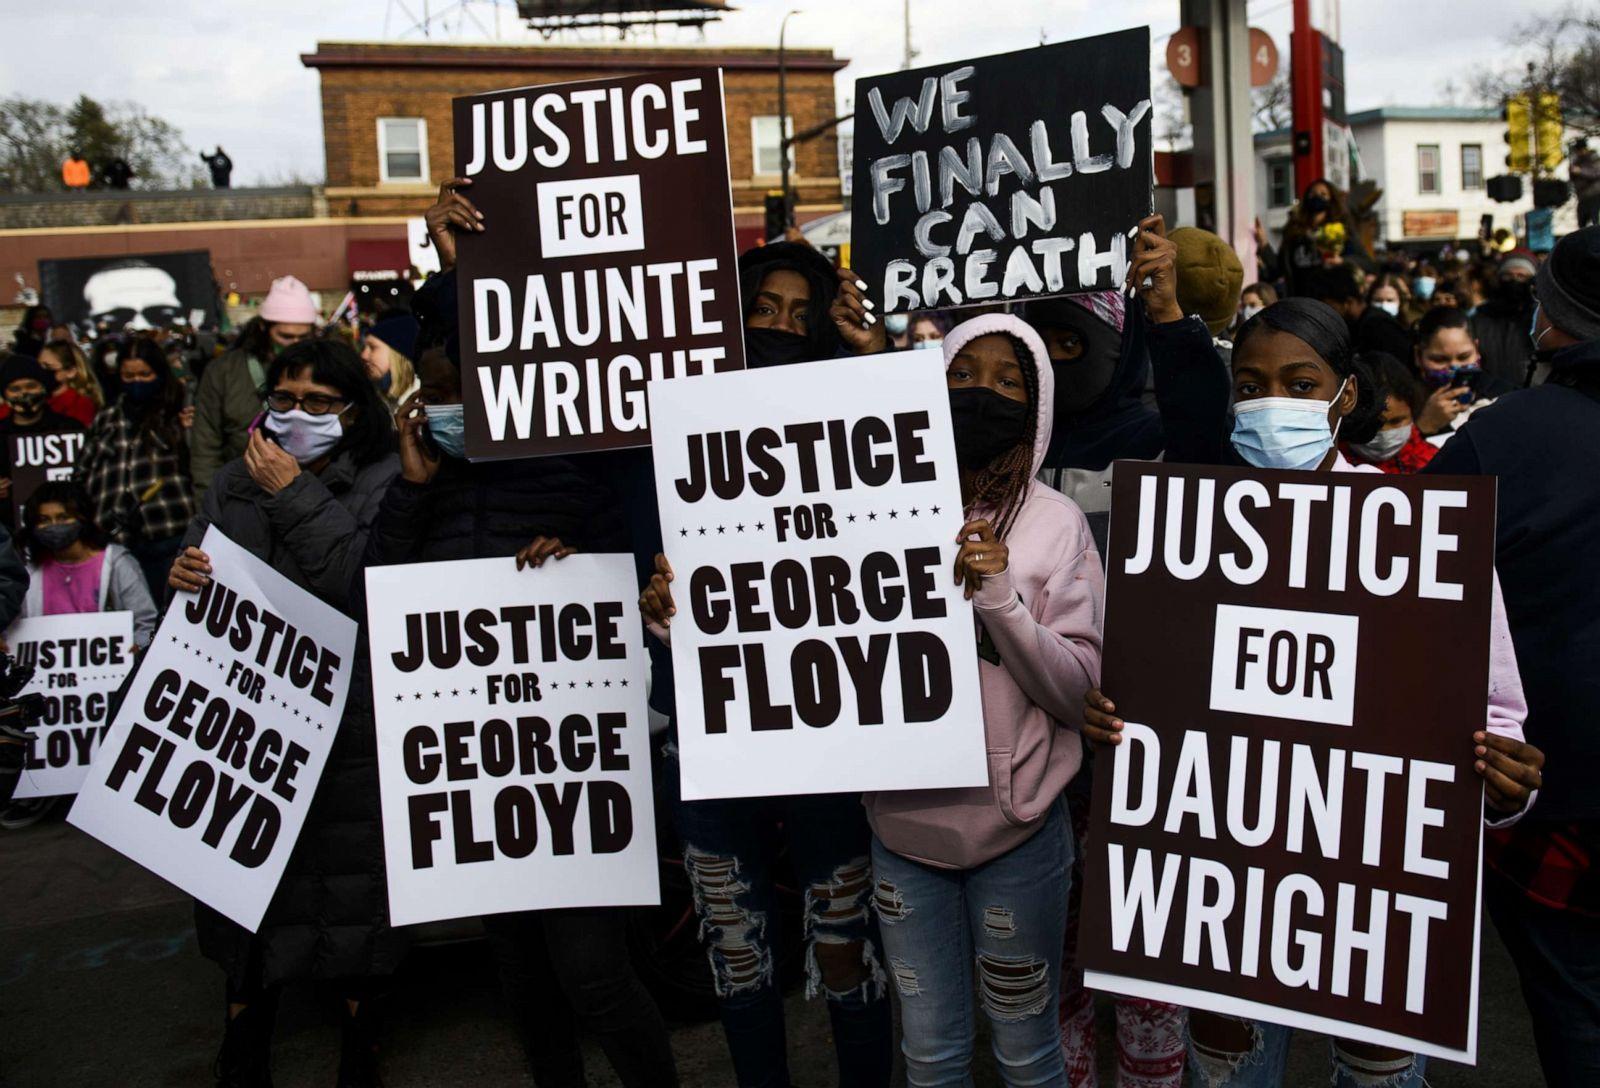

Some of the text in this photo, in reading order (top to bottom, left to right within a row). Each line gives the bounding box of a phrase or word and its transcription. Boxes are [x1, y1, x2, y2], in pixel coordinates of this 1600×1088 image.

[1177, 44, 1192, 67] 3
[1256, 45, 1269, 67] 4
[465, 78, 707, 176] JUSTICE
[868, 66, 977, 144] WE
[870, 99, 1152, 225] FINALLY
[556, 191, 628, 240] FOR
[914, 186, 1056, 258] CAN
[473, 258, 723, 353] DAUNTE
[675, 410, 936, 503] JUSTICE
[773, 503, 838, 542] FOR
[1124, 475, 1468, 601] JUSTICE
[690, 546, 947, 635] GEORGE
[48, 673, 77, 689] FOR
[185, 578, 341, 707] JUSTICE
[225, 659, 266, 703] FOR
[391, 601, 627, 673] JUSTICE
[1235, 627, 1335, 700] FOR
[486, 672, 542, 705] FOR
[698, 631, 953, 734] FLOYD
[143, 668, 311, 803] GEORGE
[403, 712, 630, 785] GEORGE
[105, 722, 282, 869] FLOYD
[407, 780, 633, 870] FLOYD
[1110, 721, 1456, 880] DAUNTE
[1107, 843, 1448, 1015] WRIGHT
